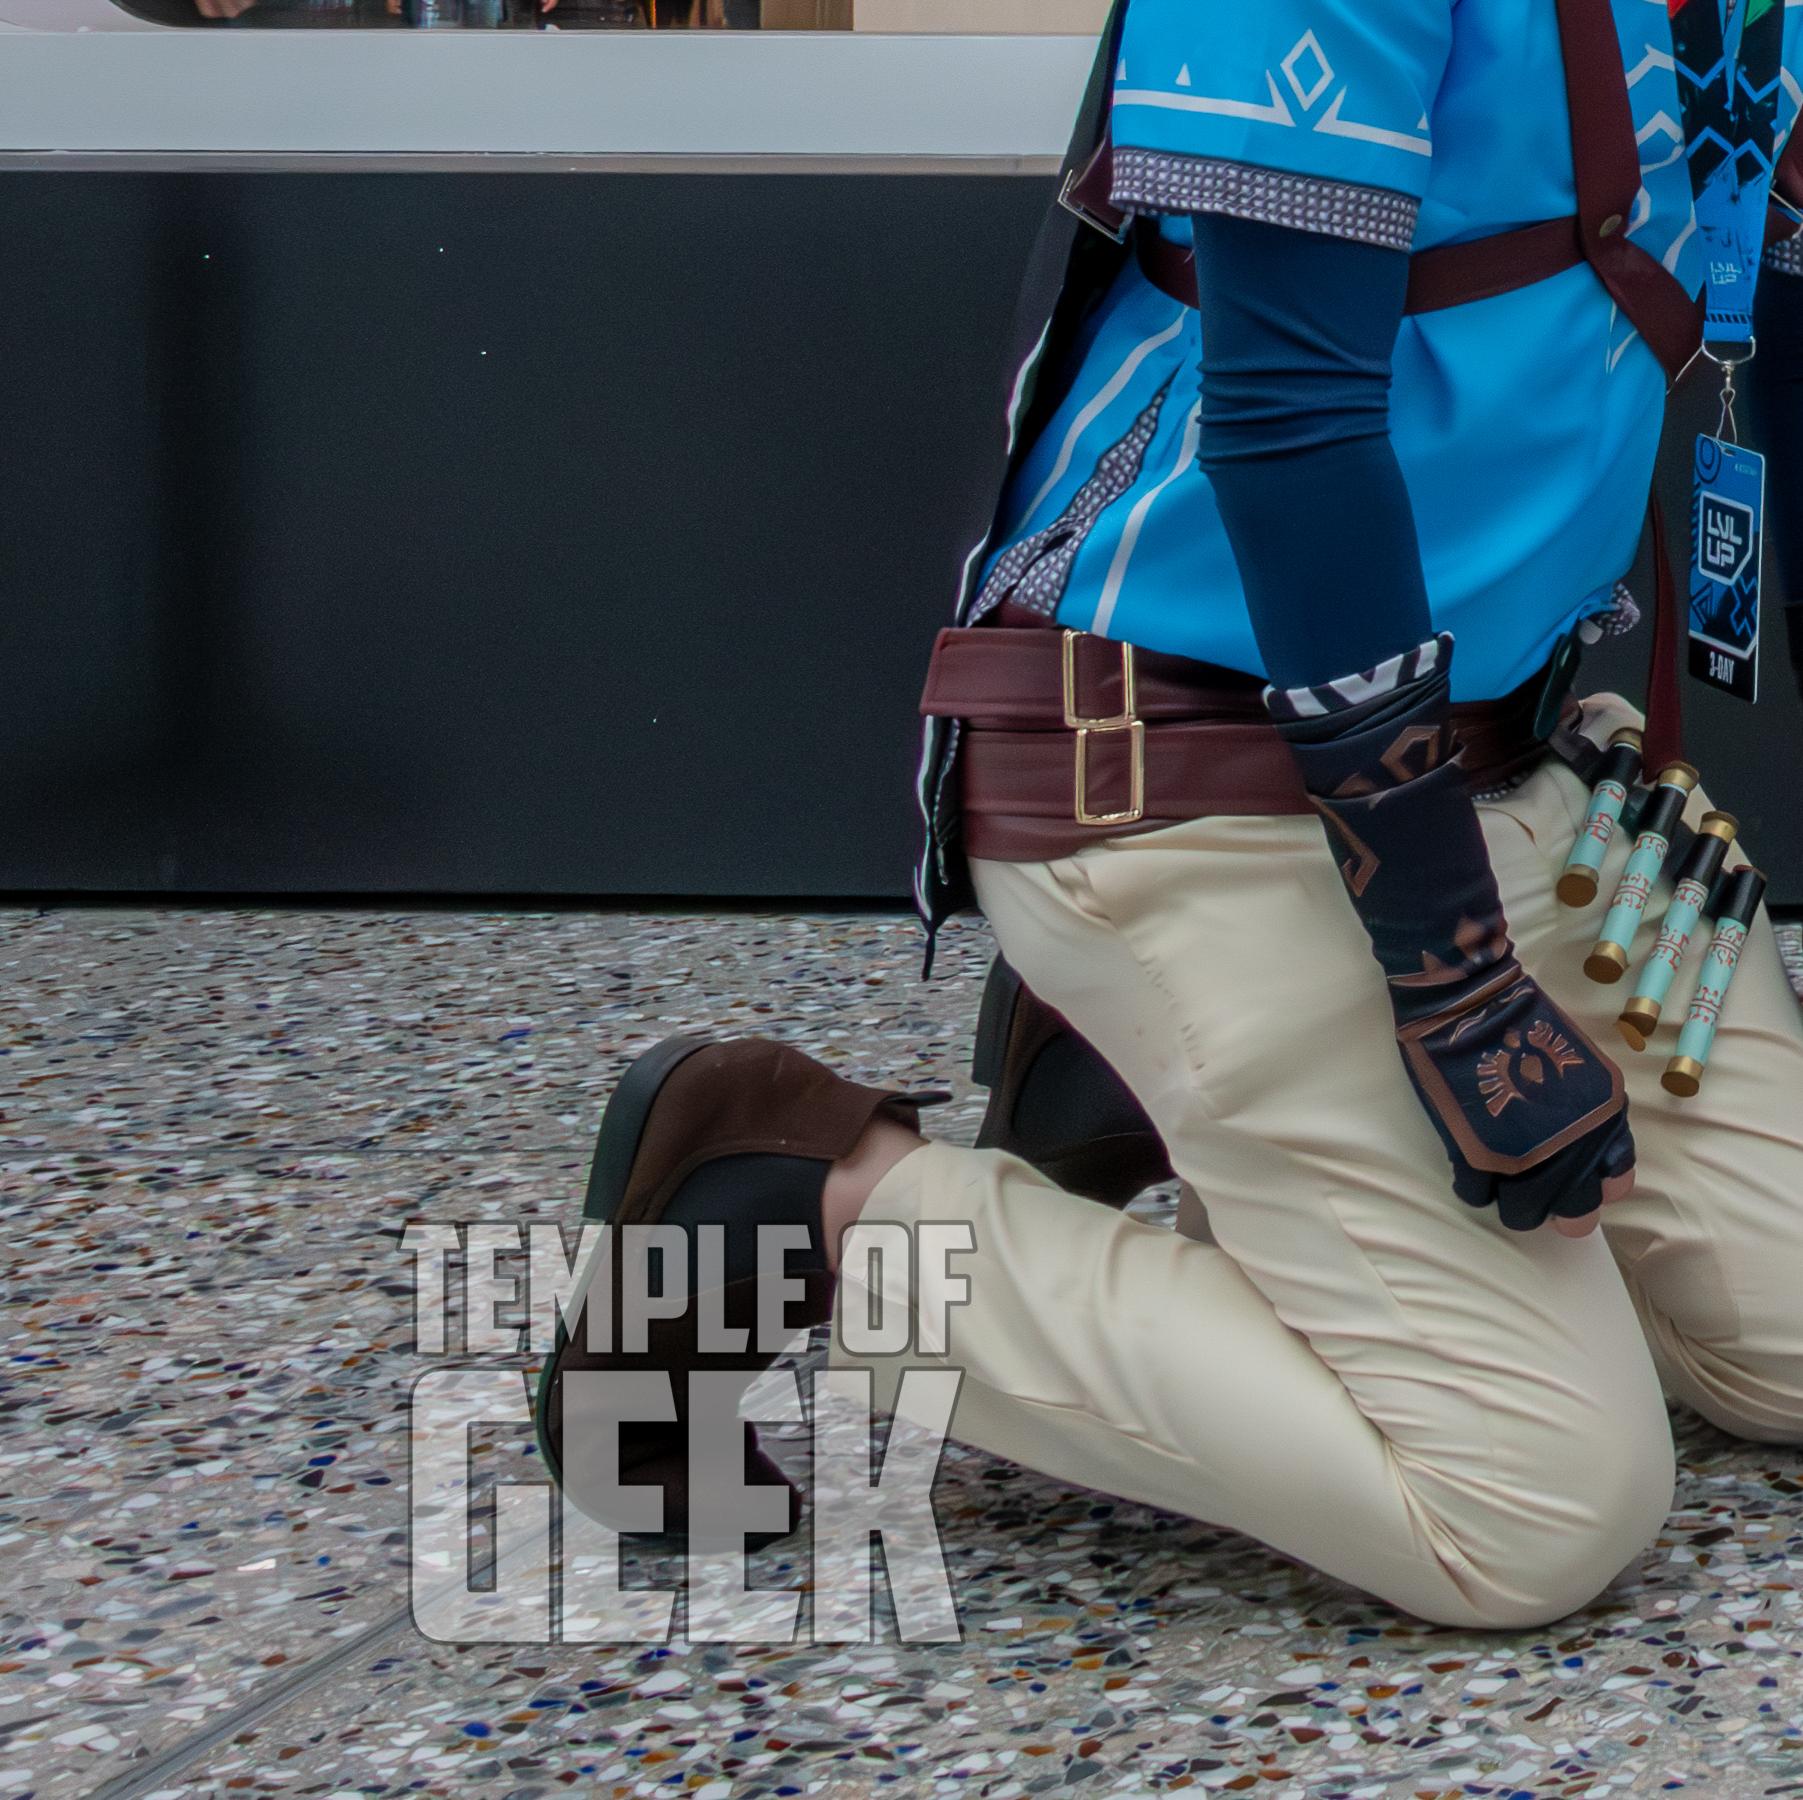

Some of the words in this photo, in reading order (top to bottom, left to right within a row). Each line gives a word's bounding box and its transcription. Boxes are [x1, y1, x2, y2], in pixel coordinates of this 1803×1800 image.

[1707, 508, 1742, 546] LVL
[1706, 536, 1735, 567] UP
[1709, 650, 1735, 685] 3-DAY
